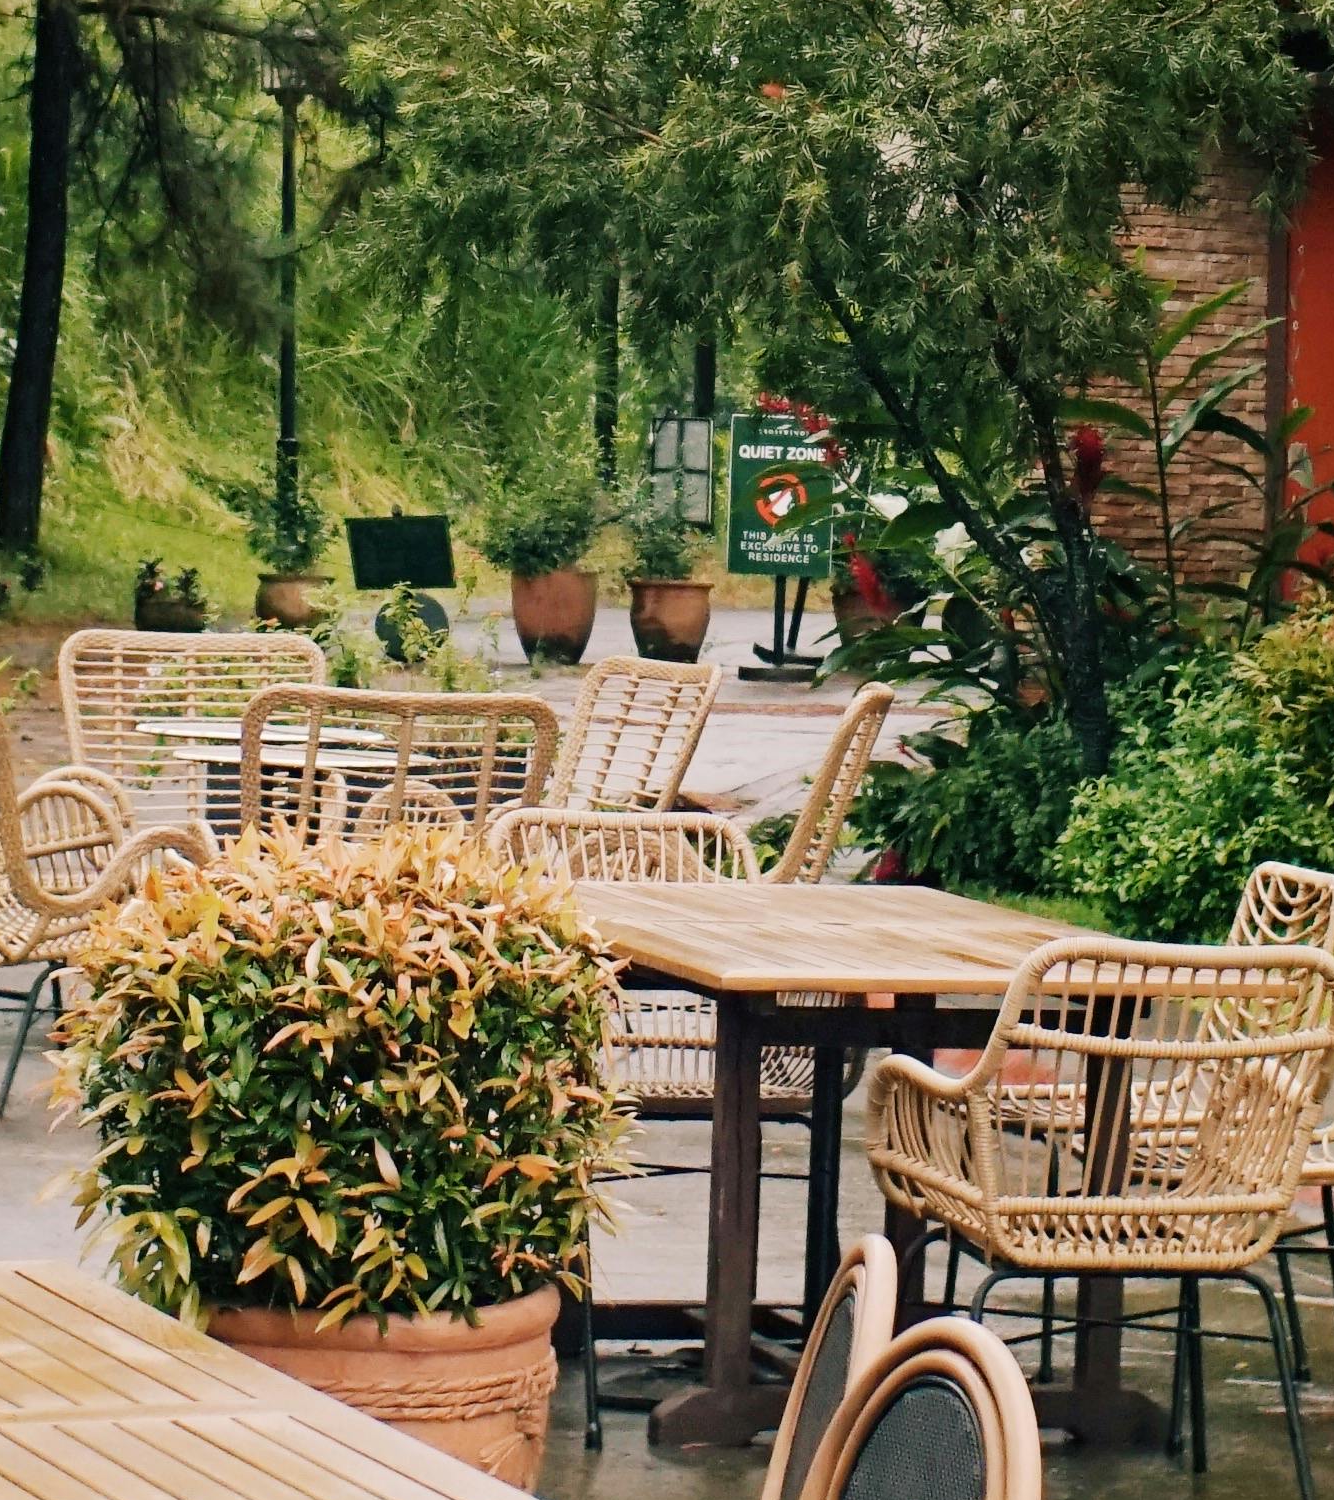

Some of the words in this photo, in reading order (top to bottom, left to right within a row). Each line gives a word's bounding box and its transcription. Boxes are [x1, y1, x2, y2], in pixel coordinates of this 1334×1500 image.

[739, 444, 784, 460] QUIET
[785, 446, 827, 462] ZONE
[742, 530, 767, 541] THIS
[803, 533, 815, 543] IS
[803, 543, 819, 554] TO
[748, 551, 810, 564] RESIDENCE
